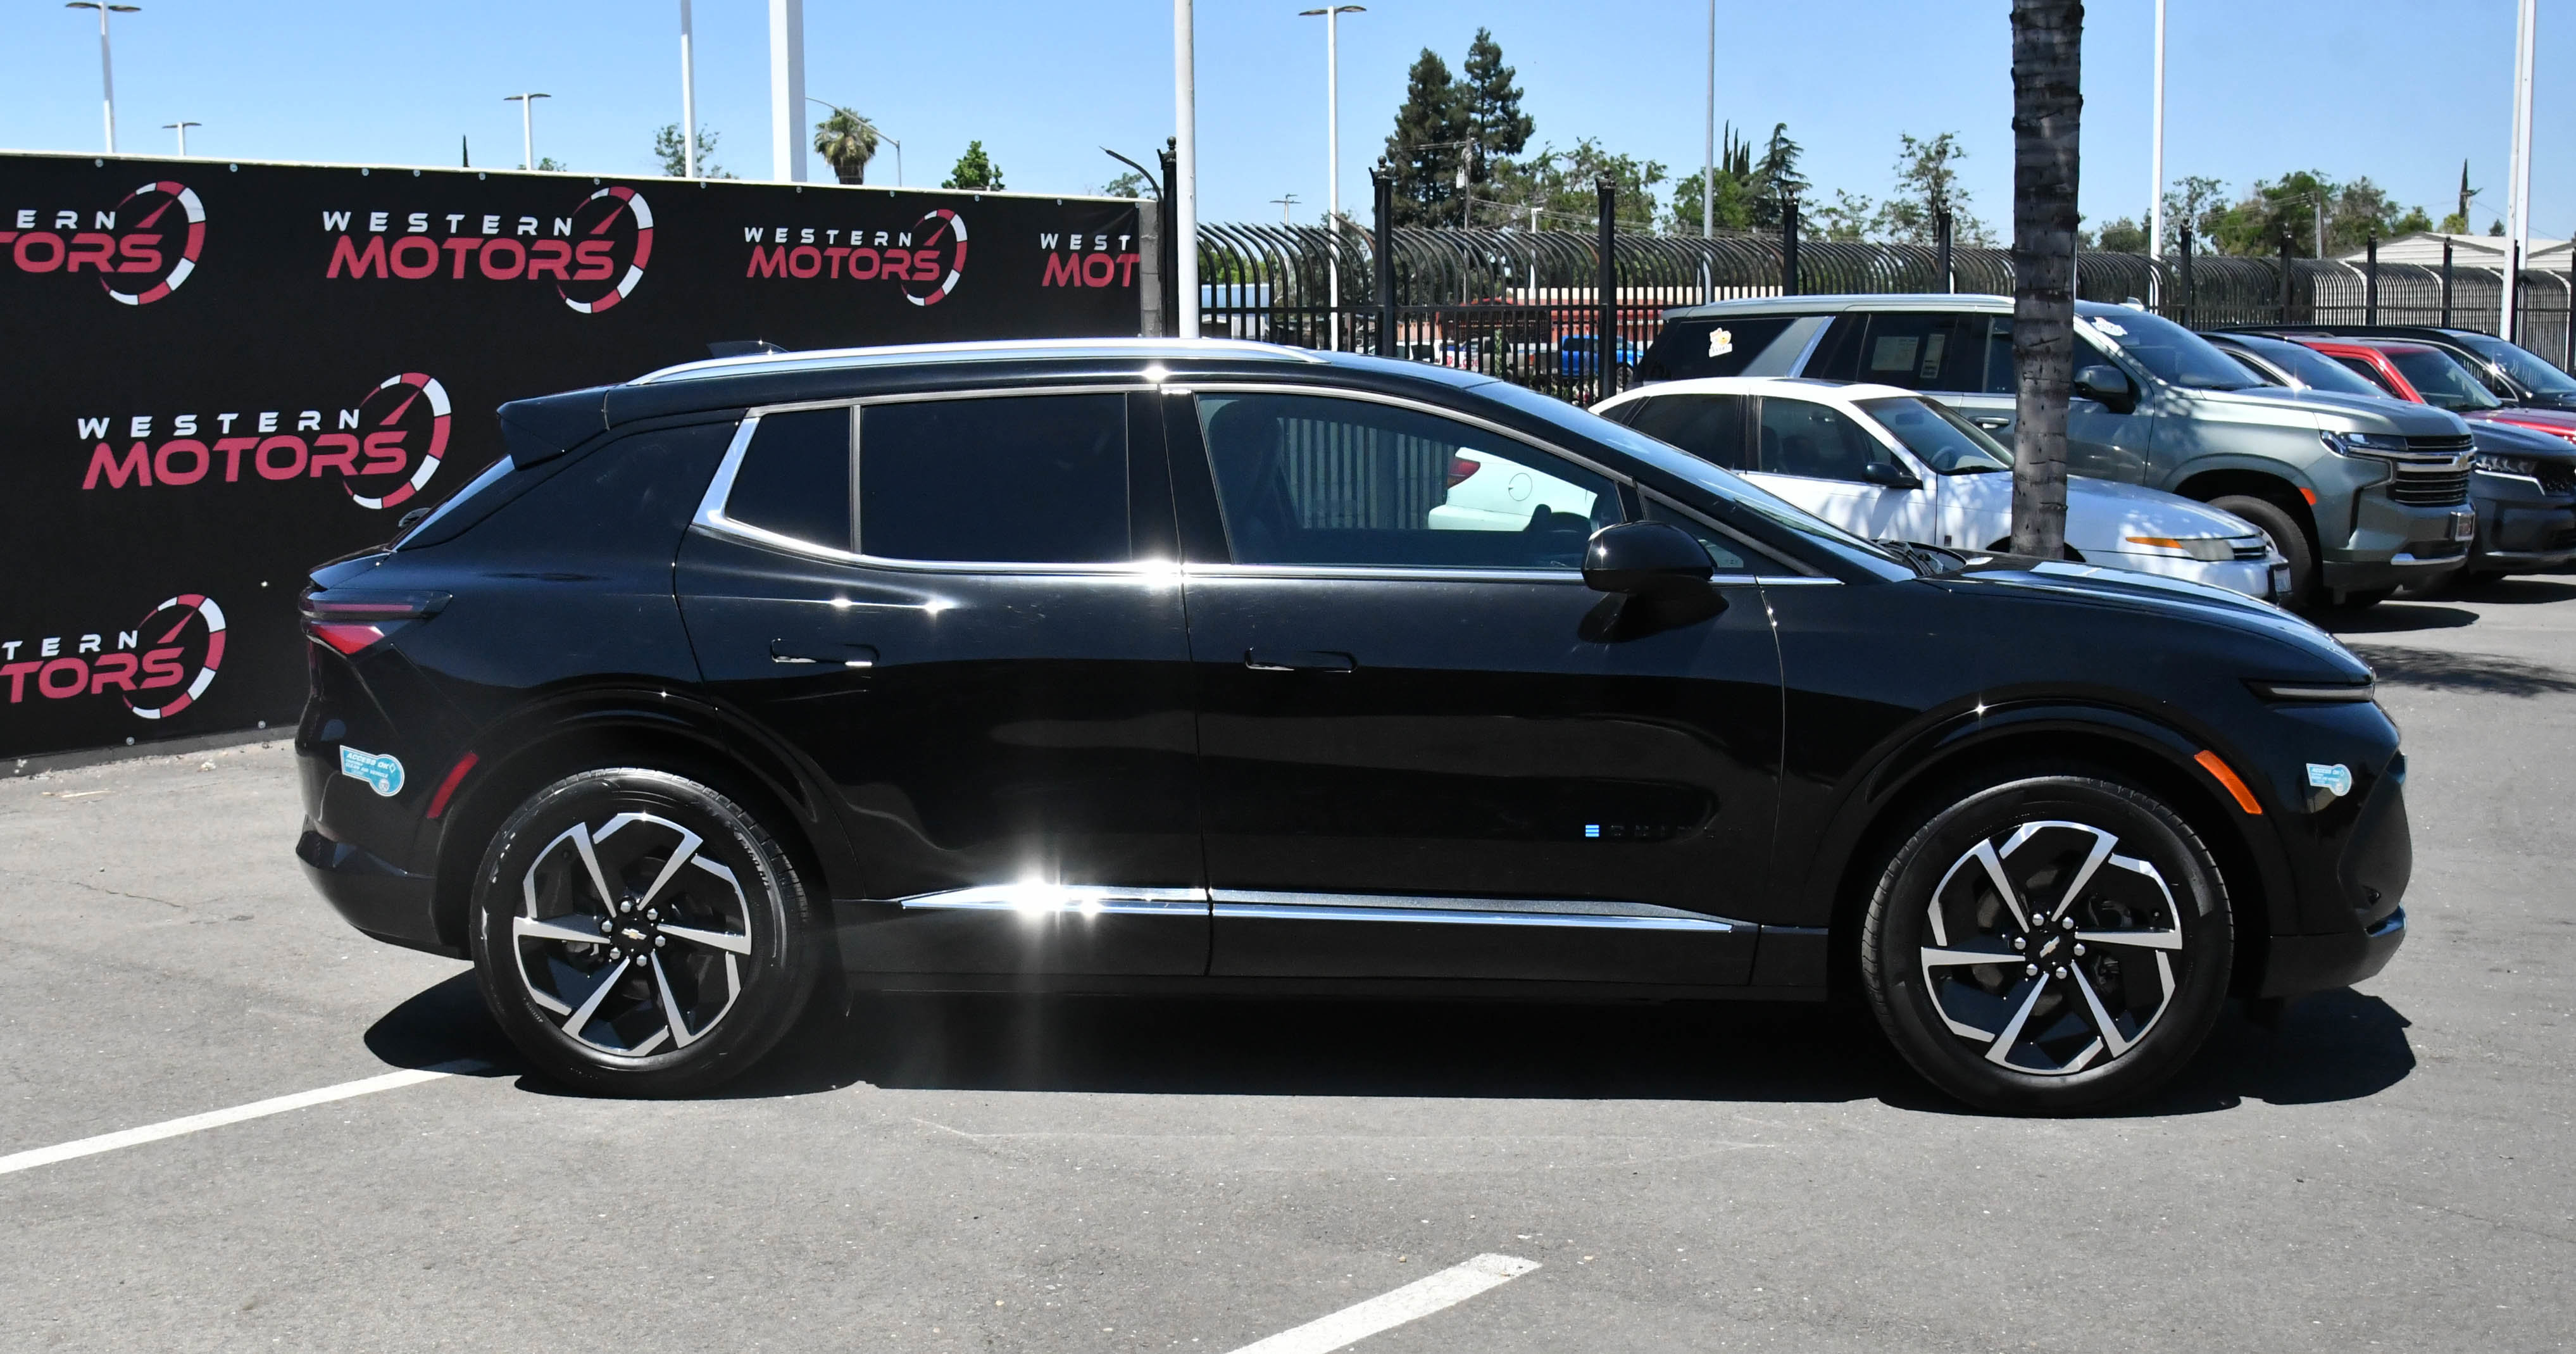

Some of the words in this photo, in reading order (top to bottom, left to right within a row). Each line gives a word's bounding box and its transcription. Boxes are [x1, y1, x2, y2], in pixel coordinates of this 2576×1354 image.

[16, 210, 116, 230] ERN
[323, 211, 572, 236] WESTERN
[744, 227, 911, 247] WESTERN
[1041, 233, 1131, 251] WEST
[326, 235, 615, 280] MOTORS
[746, 245, 941, 281] MOTORS
[1042, 252, 1141, 287] MOT
[77, 409, 360, 440] WESTERN
[82, 430, 408, 490] MOTORS
[2, 630, 138, 660] TERN
[0, 647, 184, 703] TORS
[346, 753, 377, 765] ACCESS
[377, 761, 390, 770] OK
